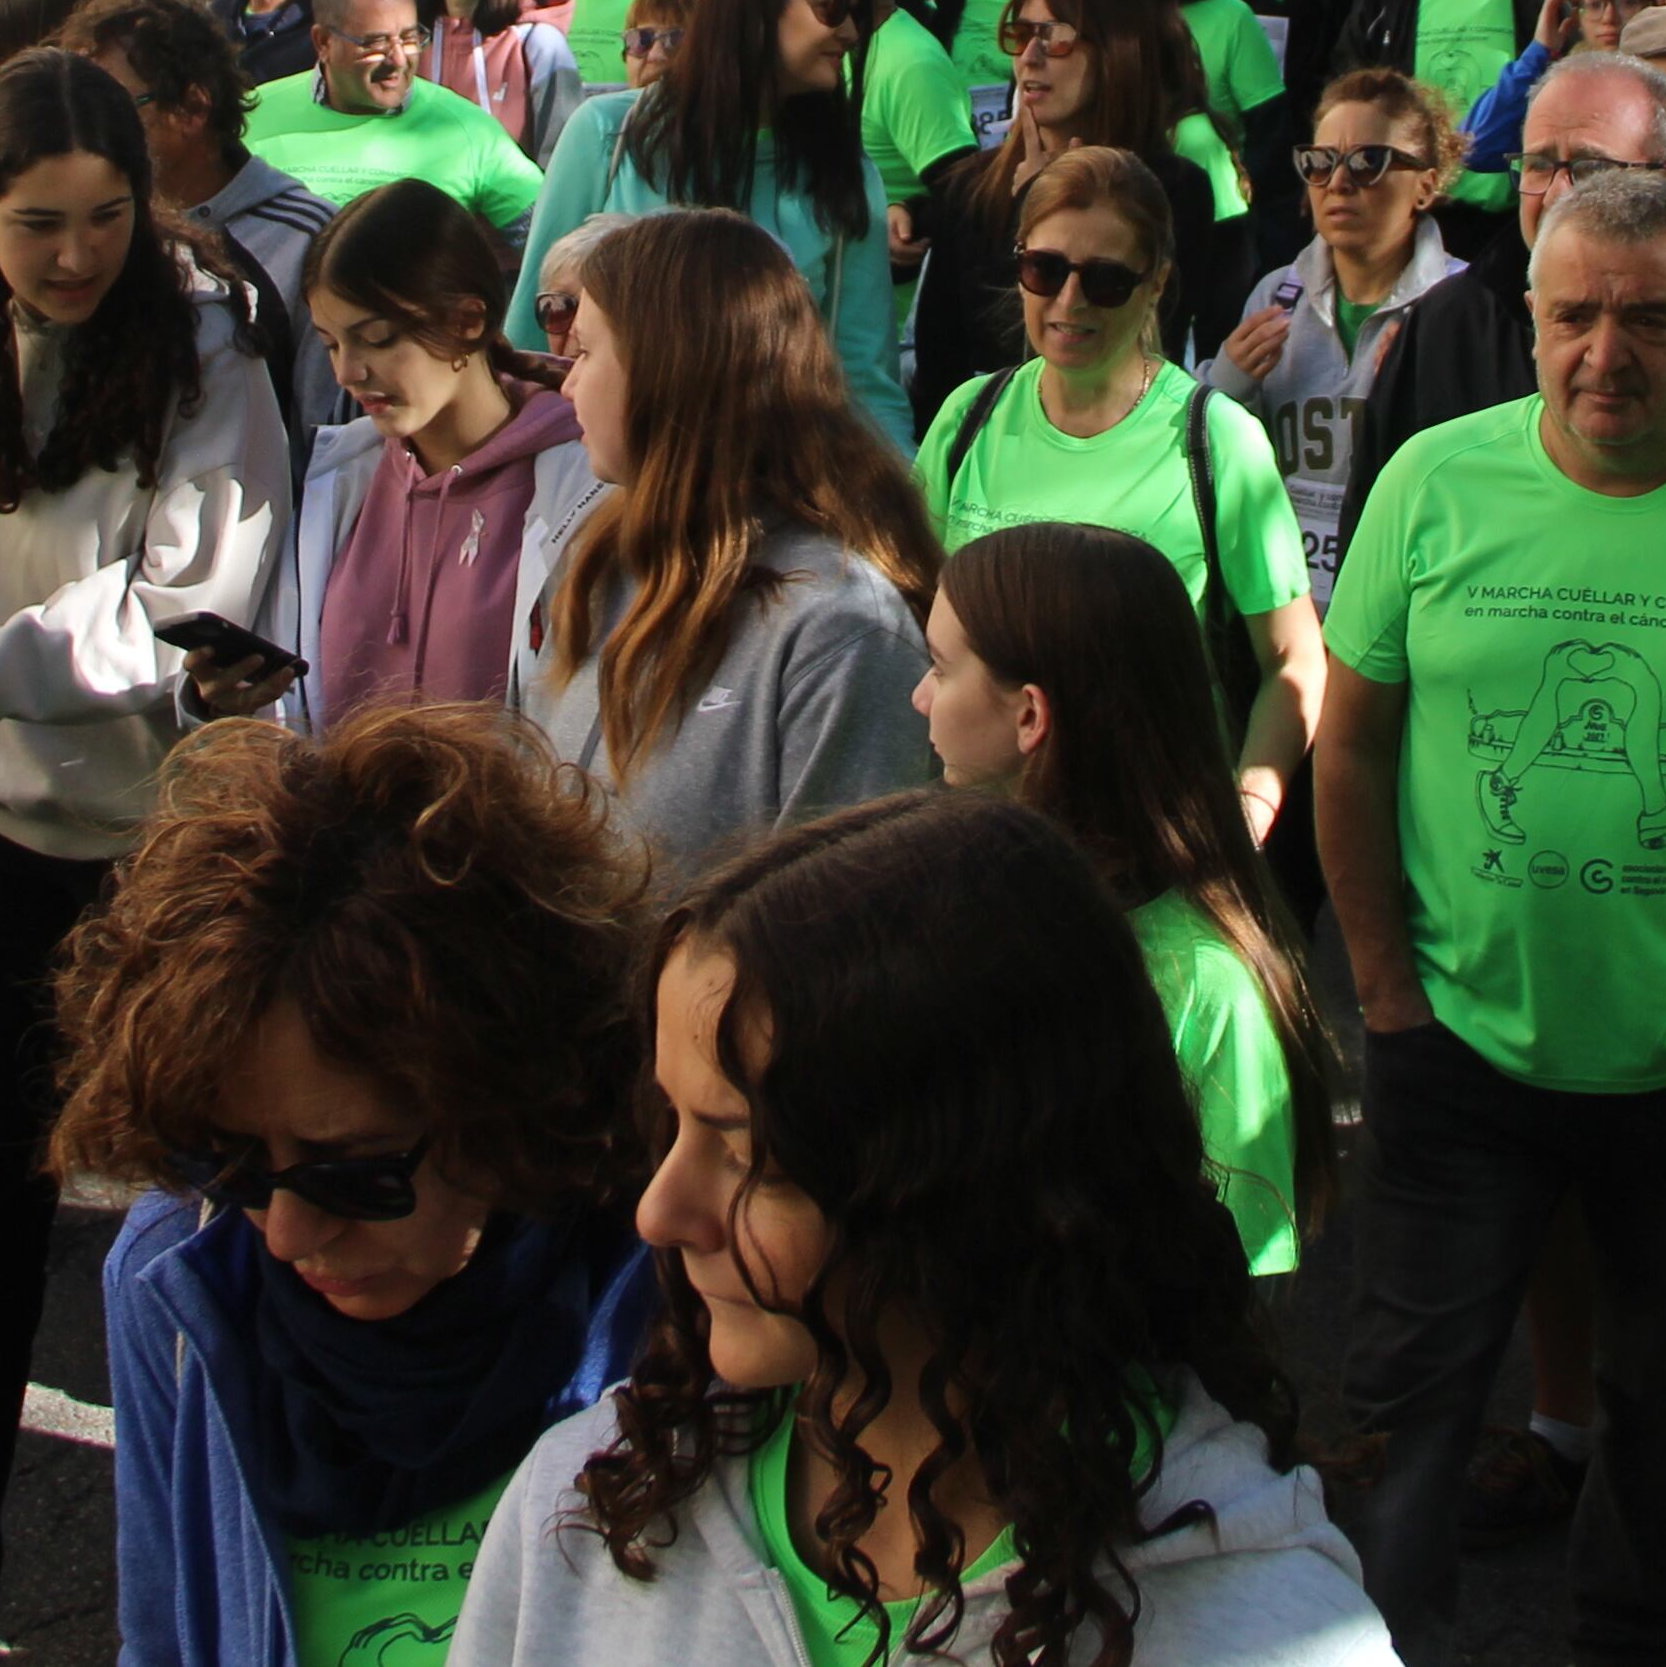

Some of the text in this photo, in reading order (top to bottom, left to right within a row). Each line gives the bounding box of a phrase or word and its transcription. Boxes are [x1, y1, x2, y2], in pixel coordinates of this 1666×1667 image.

[1467, 585, 1478, 599] V
[1481, 586, 1553, 601] MARCHA
[1557, 585, 1636, 607] CUÉLLAR
[1640, 594, 1652, 607] Y
[1464, 606, 1483, 618] en
[1487, 605, 1548, 620] marcha
[1552, 607, 1606, 624] contra
[1609, 609, 1626, 624] el
[358, 1557, 449, 1583] contra
